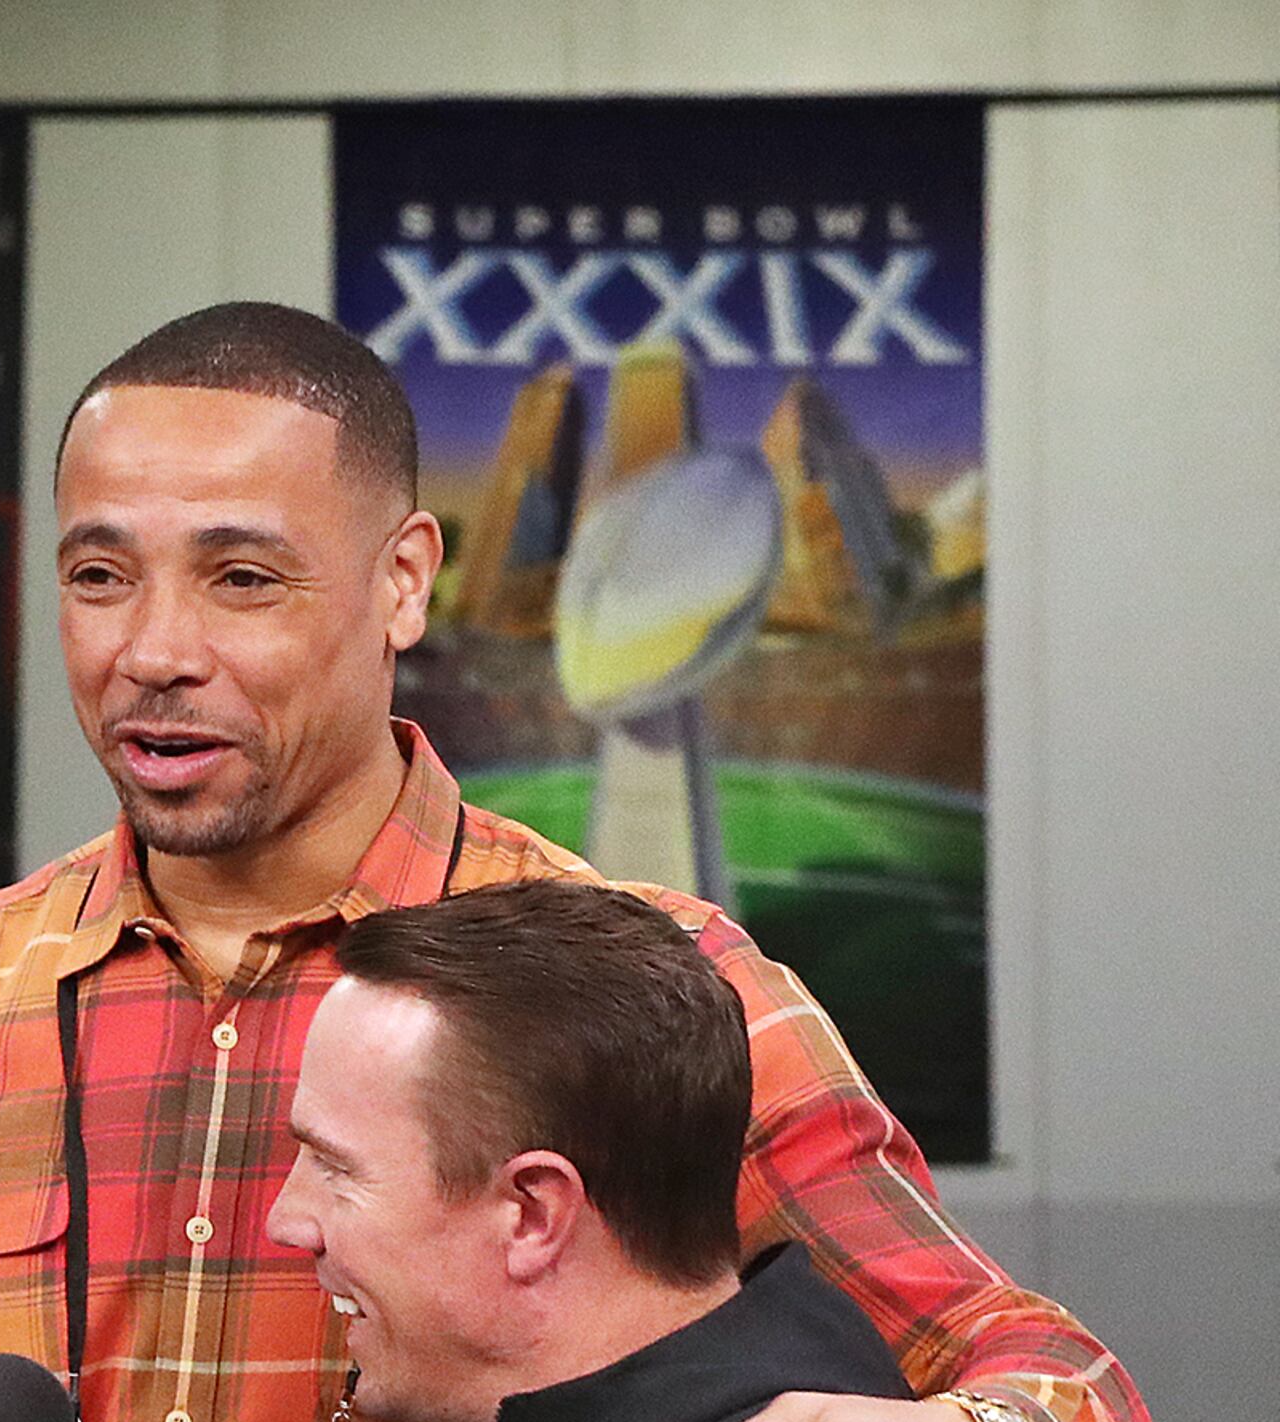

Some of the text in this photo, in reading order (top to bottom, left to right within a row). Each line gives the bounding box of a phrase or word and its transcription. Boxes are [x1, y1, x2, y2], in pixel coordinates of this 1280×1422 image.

[397, 203, 923, 243] SUPER BOWL
[363, 246, 972, 368] XXXIX
